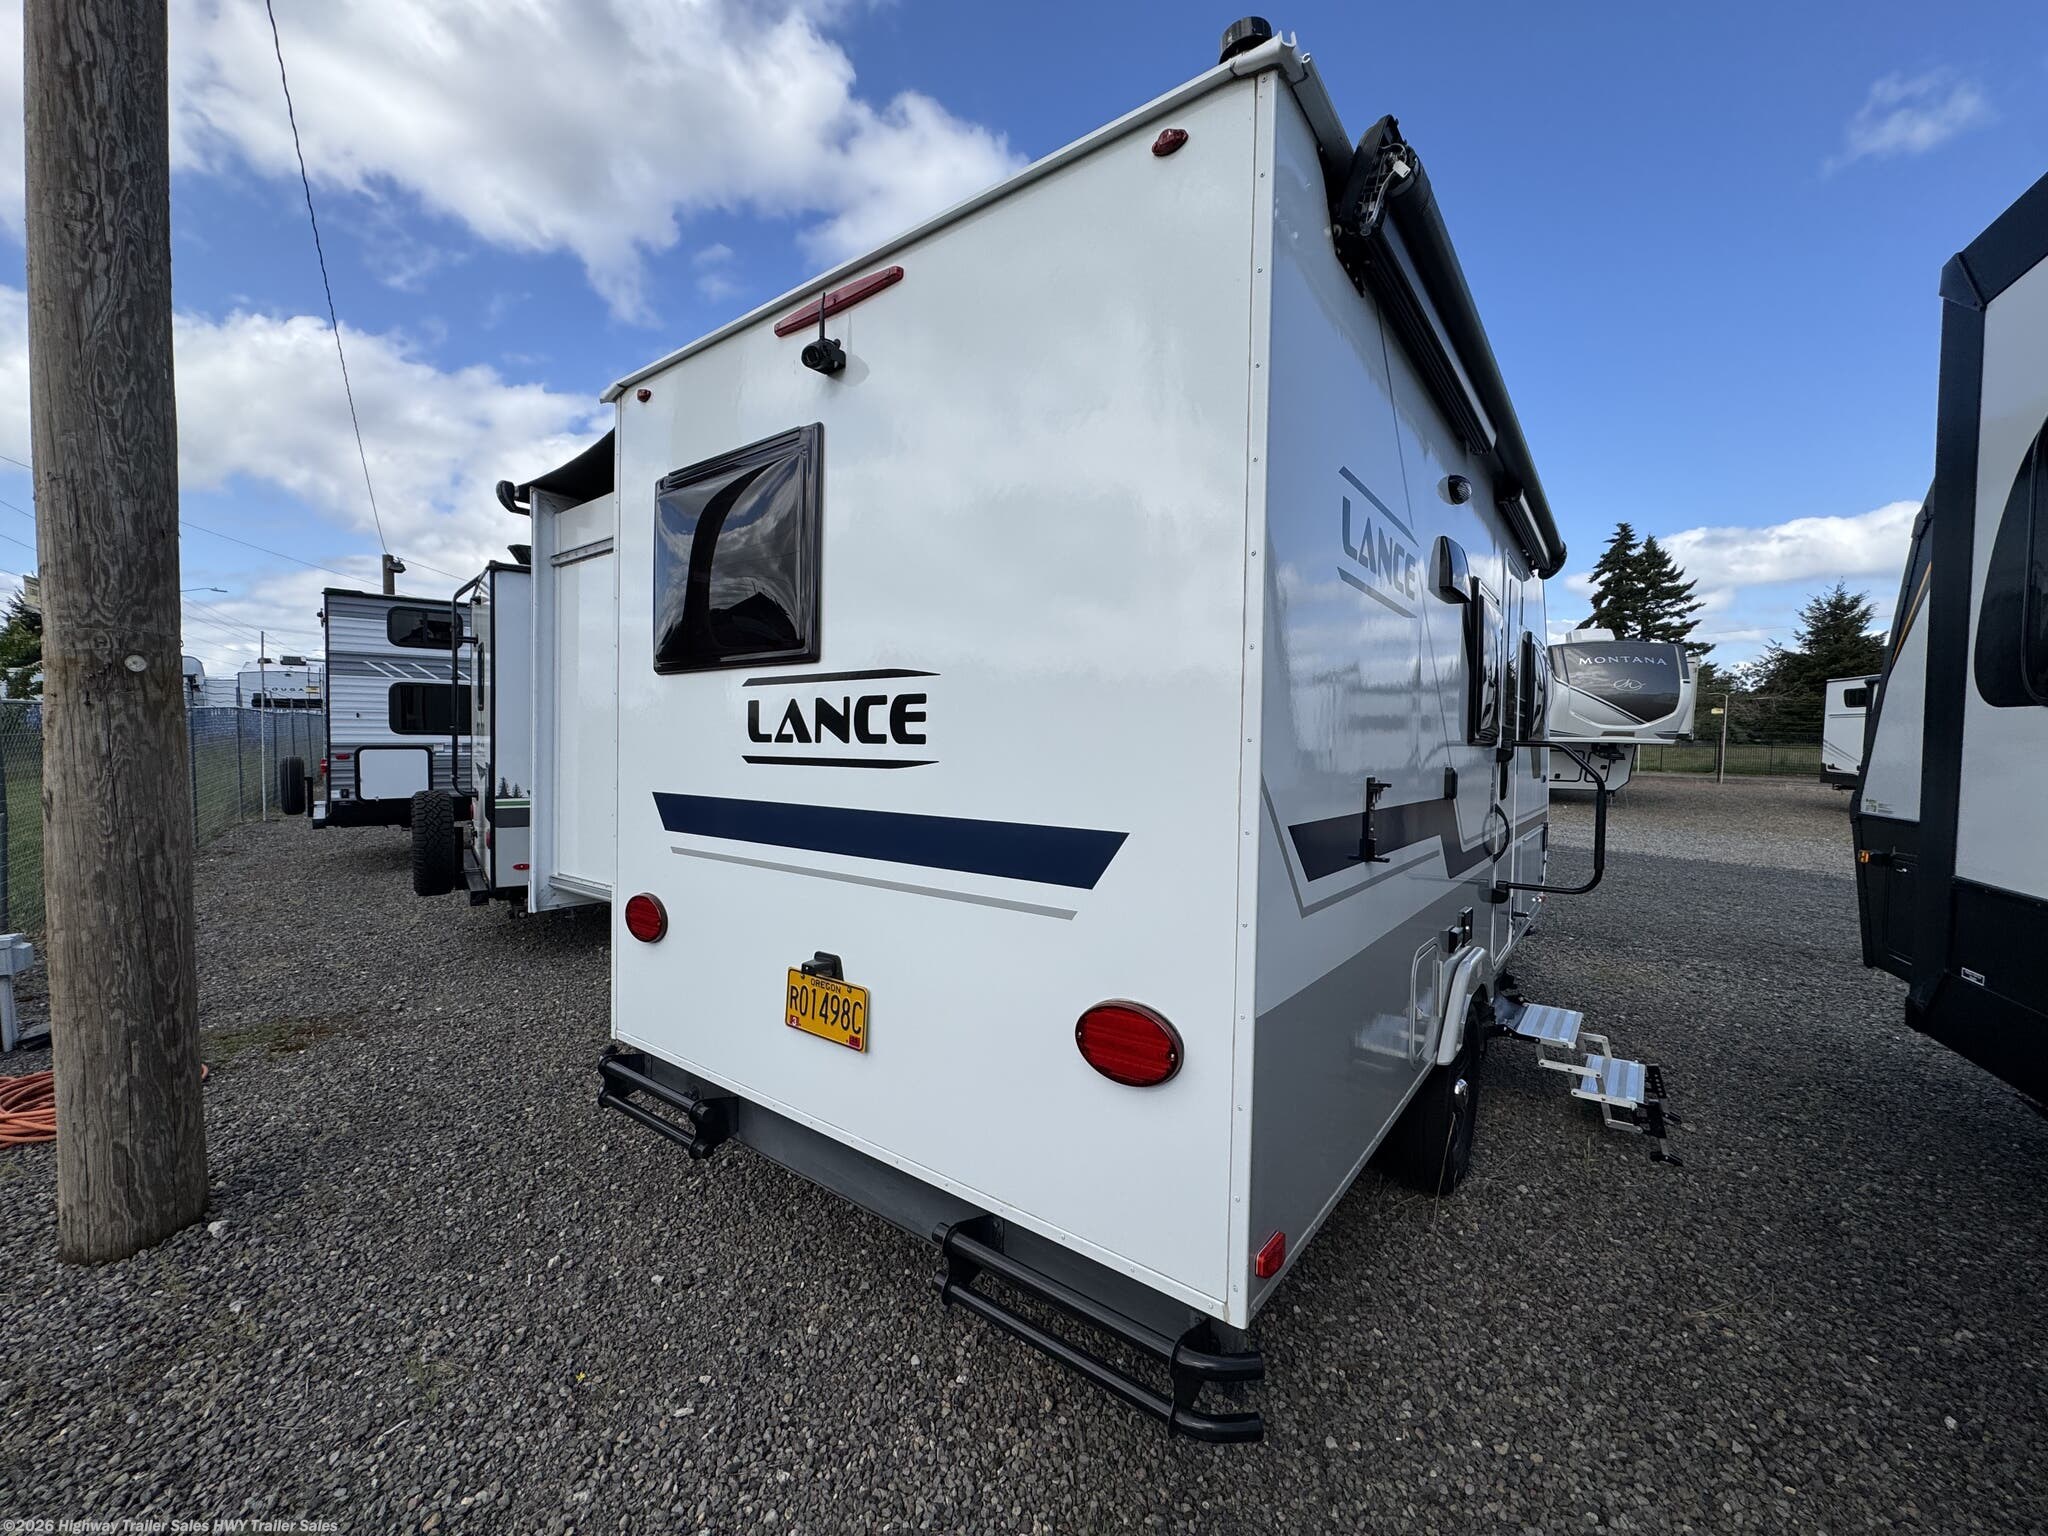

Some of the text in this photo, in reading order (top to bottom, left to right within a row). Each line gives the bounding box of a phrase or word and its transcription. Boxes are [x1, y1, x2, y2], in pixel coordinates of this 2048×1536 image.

[1342, 495, 1417, 601] LANCE
[1578, 655, 1668, 666] MONTANA
[748, 693, 927, 745] LANCE
[790, 985, 863, 1034] R01498C
[810, 978, 841, 994] OREGON
